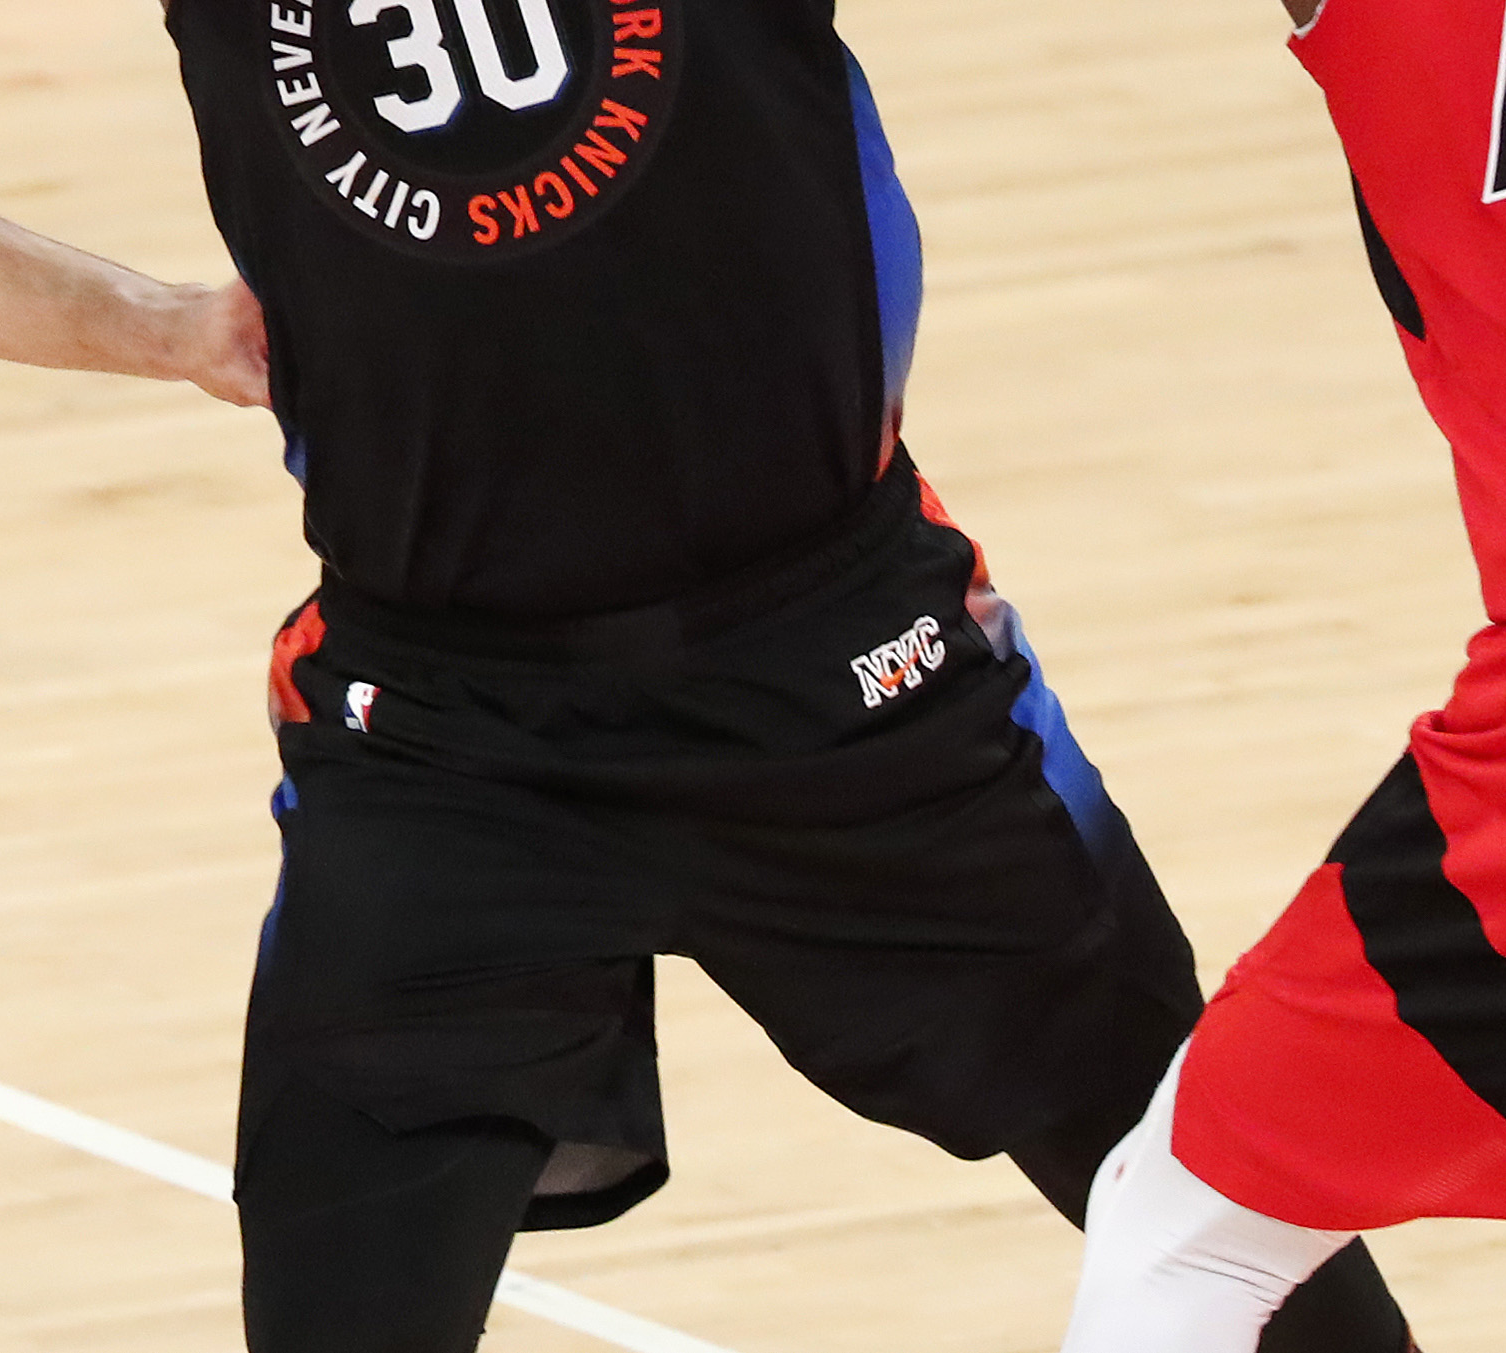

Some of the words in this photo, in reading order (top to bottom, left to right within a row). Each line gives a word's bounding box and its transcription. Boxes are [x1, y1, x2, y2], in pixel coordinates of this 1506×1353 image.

[324, 150, 442, 241] CITY
[467, 98, 649, 245] KNICKS
[850, 615, 946, 709] NYC
